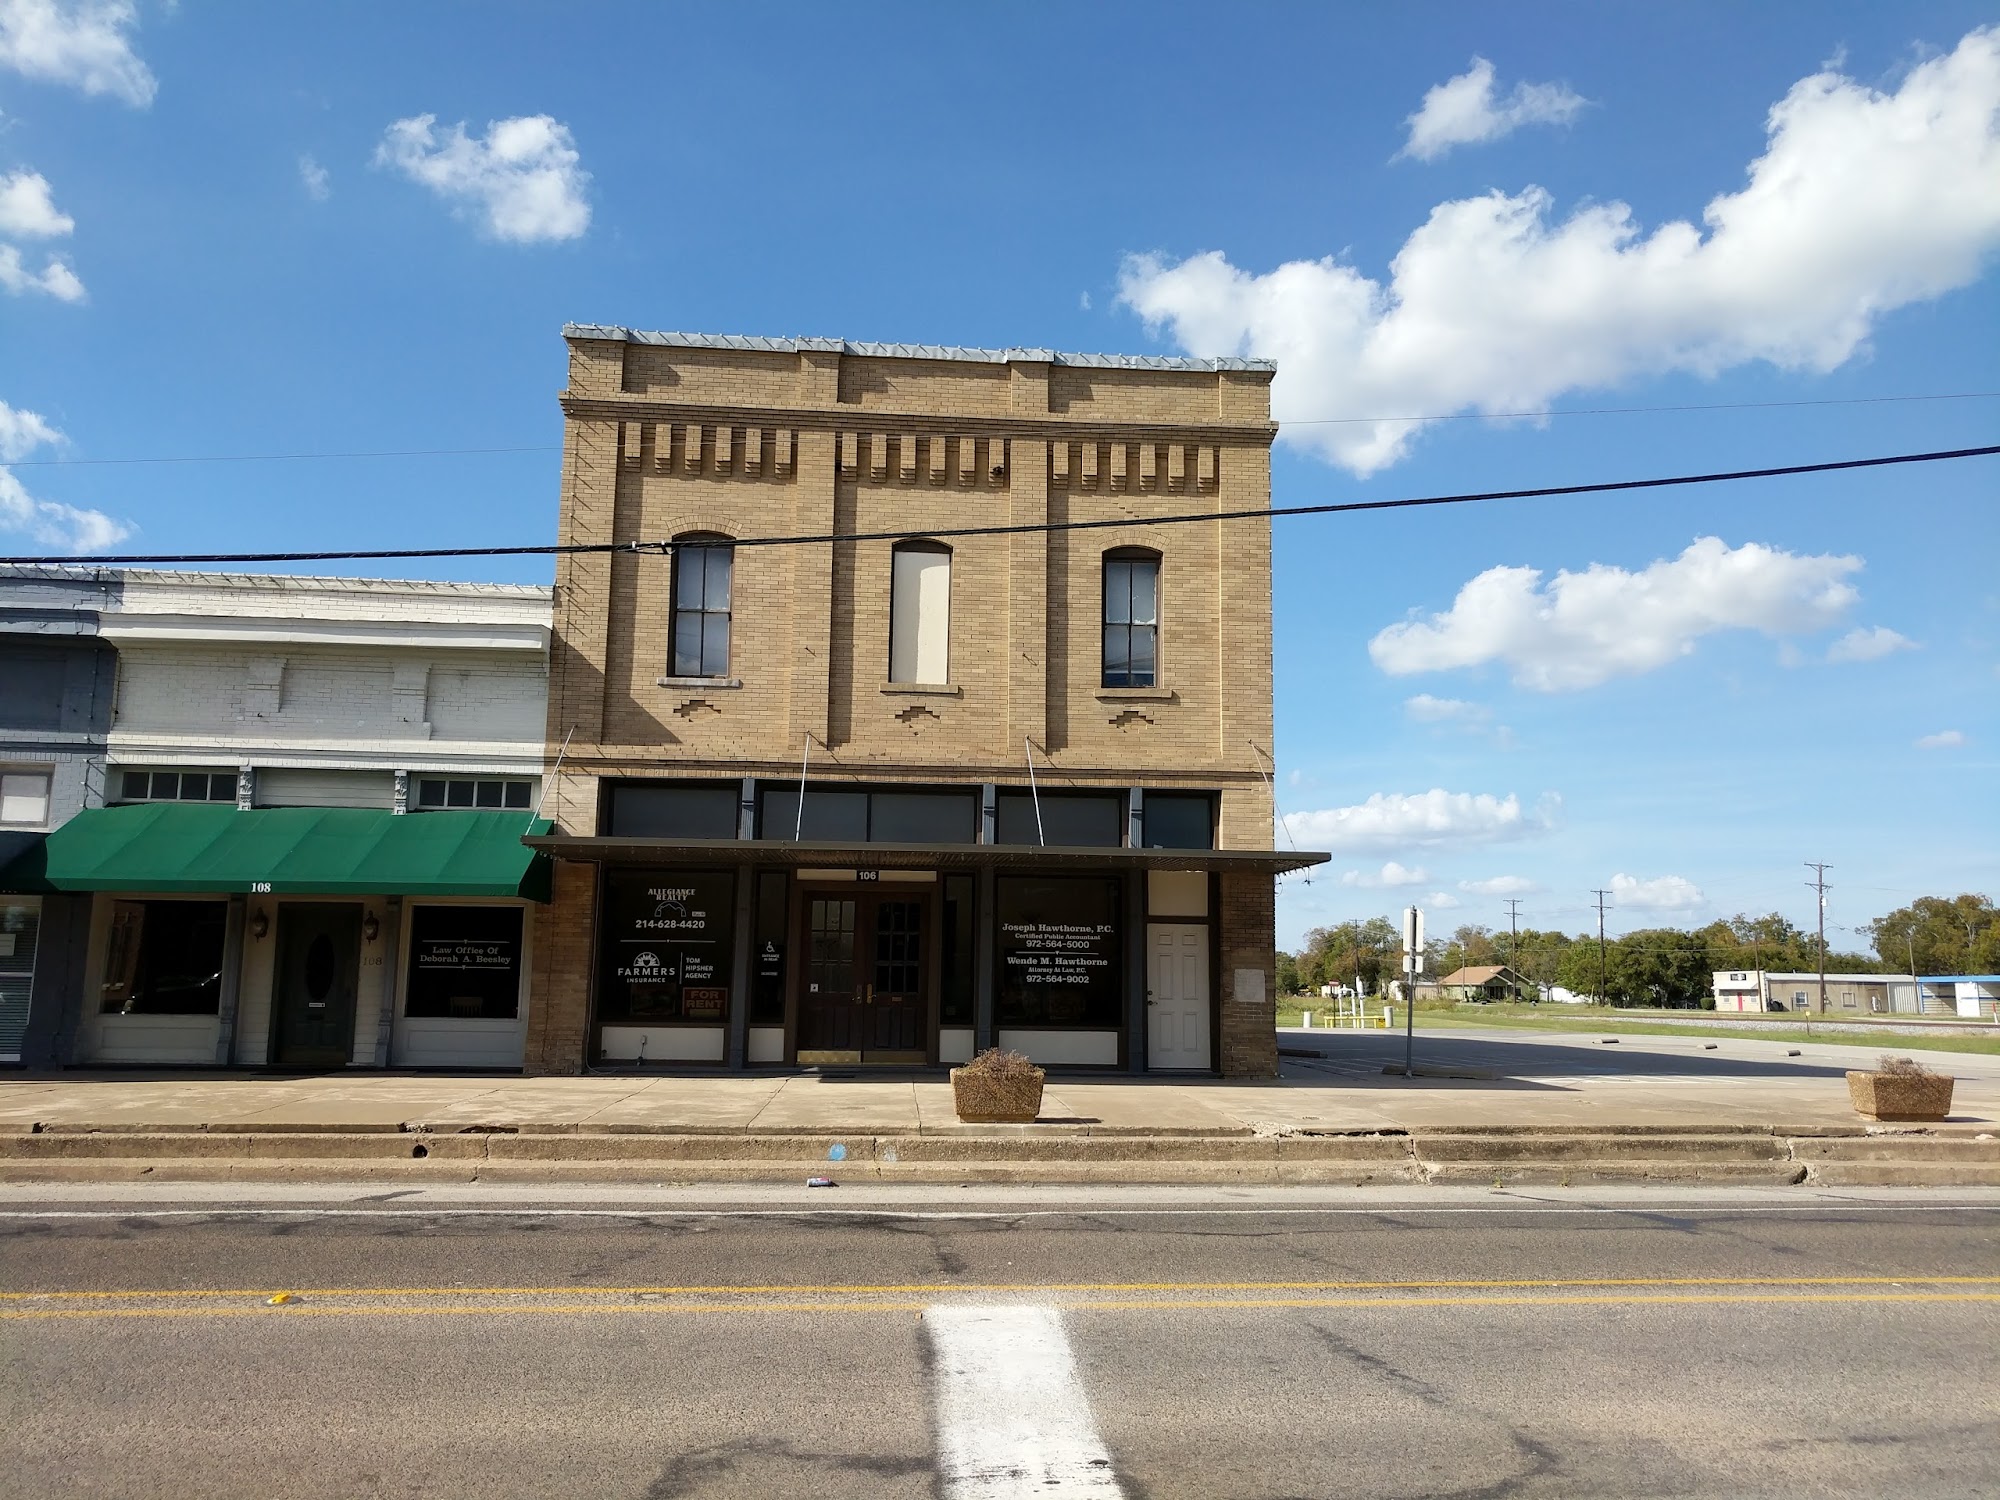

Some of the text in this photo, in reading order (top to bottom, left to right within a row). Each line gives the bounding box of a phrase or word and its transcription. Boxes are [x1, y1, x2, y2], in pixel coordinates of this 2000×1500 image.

[859, 871, 876, 880] 106
[251, 882, 271, 893] 108
[635, 919, 705, 929] 214-628-4420
[1002, 923, 1114, 933] Joseph Hawthorne, P.C.
[1026, 939, 1090, 949] 972-564-5000
[432, 946, 499, 955] Law Office Of
[363, 956, 383, 966] 108
[420, 954, 458, 963] Deborah
[476, 955, 511, 965] Beesley
[1007, 956, 1108, 966] Wende M. Hawthorne
[617, 967, 676, 976] FARMERS
[1026, 975, 1090, 984] 972-564-9002
[690, 990, 719, 999] FOR
[686, 1000, 724, 1008] RENT
